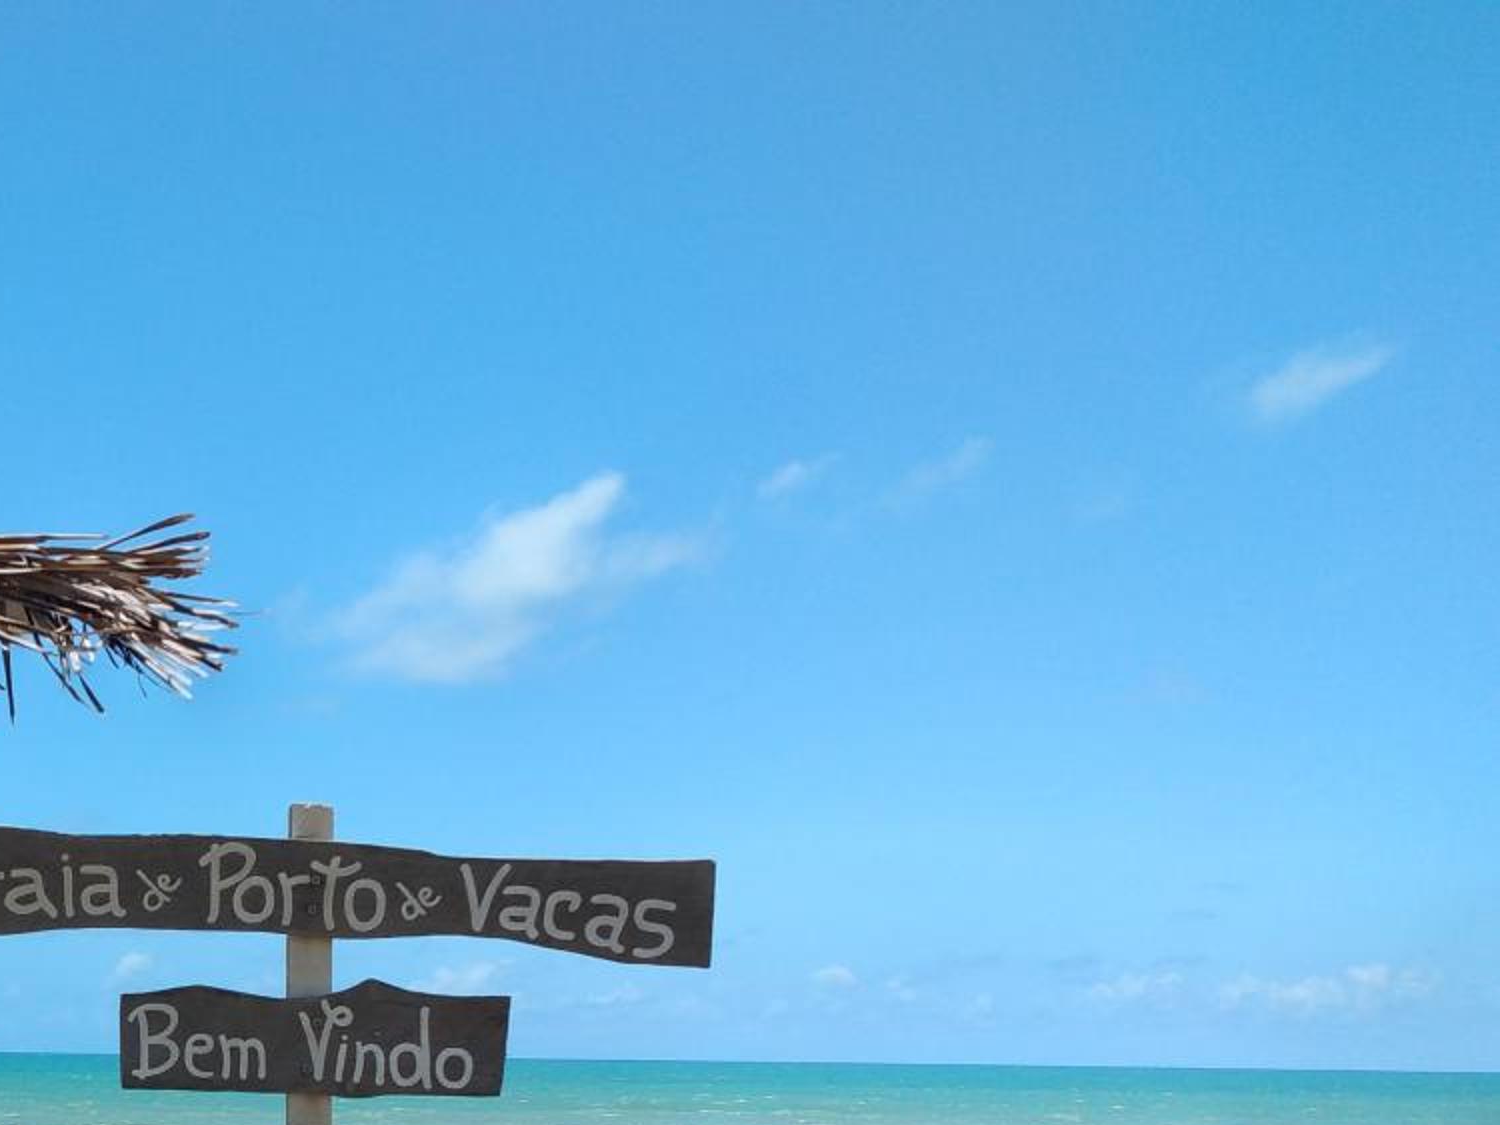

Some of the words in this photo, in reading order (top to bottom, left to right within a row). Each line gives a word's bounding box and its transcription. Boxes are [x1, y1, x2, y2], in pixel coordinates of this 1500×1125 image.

[137, 868, 182, 912] de
[199, 842, 388, 931] Porto
[395, 881, 442, 923] de
[461, 862, 677, 959] Vacas
[127, 1003, 267, 1079] Bem
[299, 999, 474, 1090] Vindo
